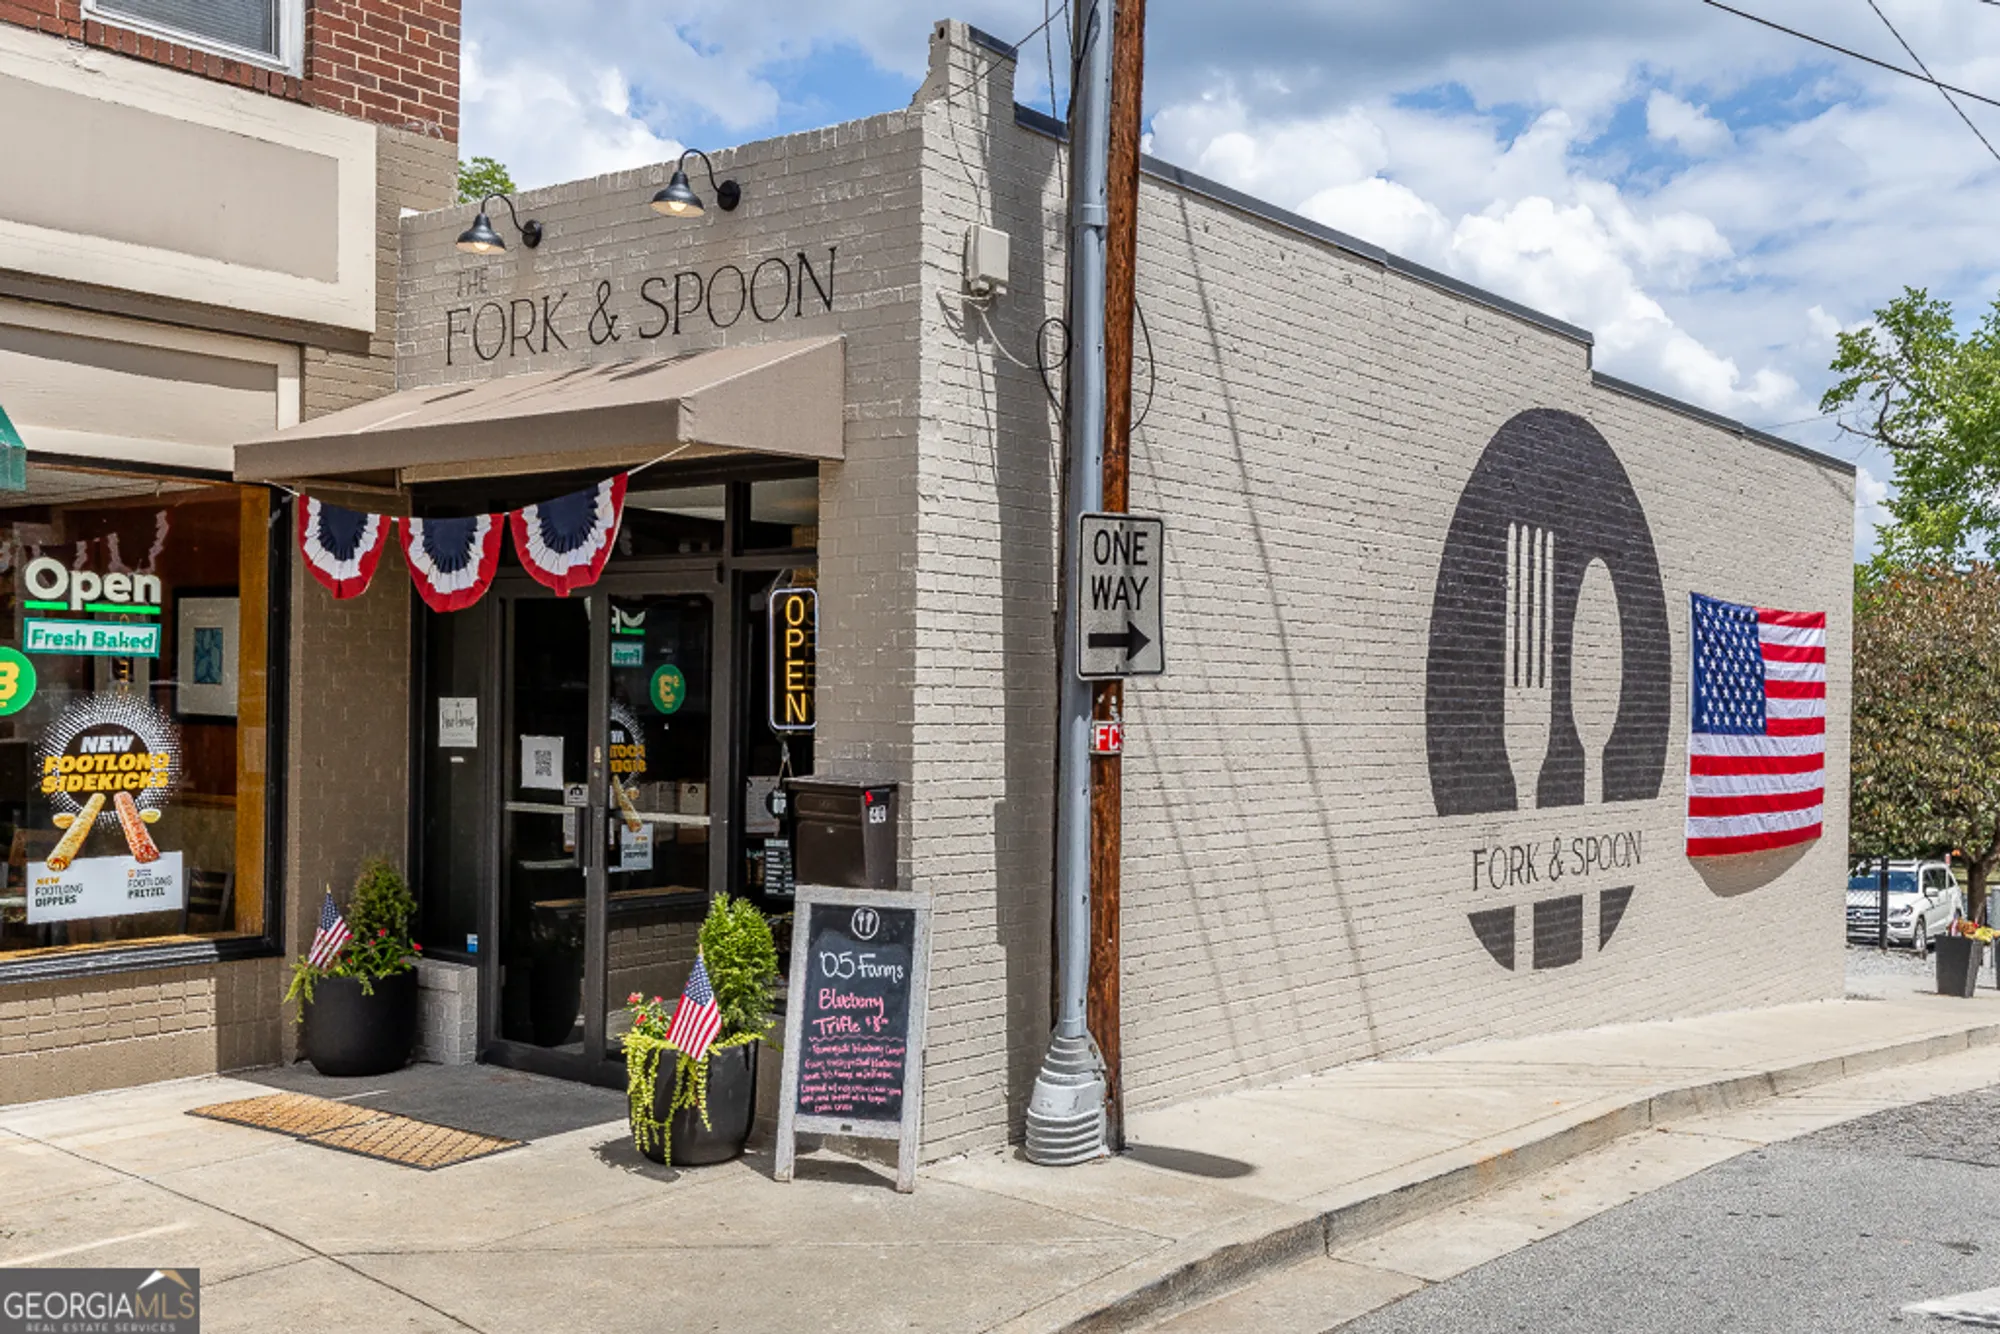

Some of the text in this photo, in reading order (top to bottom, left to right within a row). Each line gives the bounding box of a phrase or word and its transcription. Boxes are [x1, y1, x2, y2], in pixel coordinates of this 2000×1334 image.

[455, 265, 488, 298] THE
[445, 246, 838, 366] FORK & SPOON
[1093, 528, 1149, 566] ONE
[25, 556, 162, 611] Open
[1091, 575, 1150, 611] WAY
[31, 628, 154, 650] Fresh Baked
[785, 594, 807, 723] OPEN
[80, 735, 134, 754] NEW
[41, 771, 169, 794] SIDEKICKS
[1472, 830, 1642, 891] FORK & SPOON
[35, 883, 83, 896] FOOTLONG
[36, 876, 60, 885] NEW
[858, 953, 904, 984] Farms
[812, 1015, 861, 1036] Trifle
